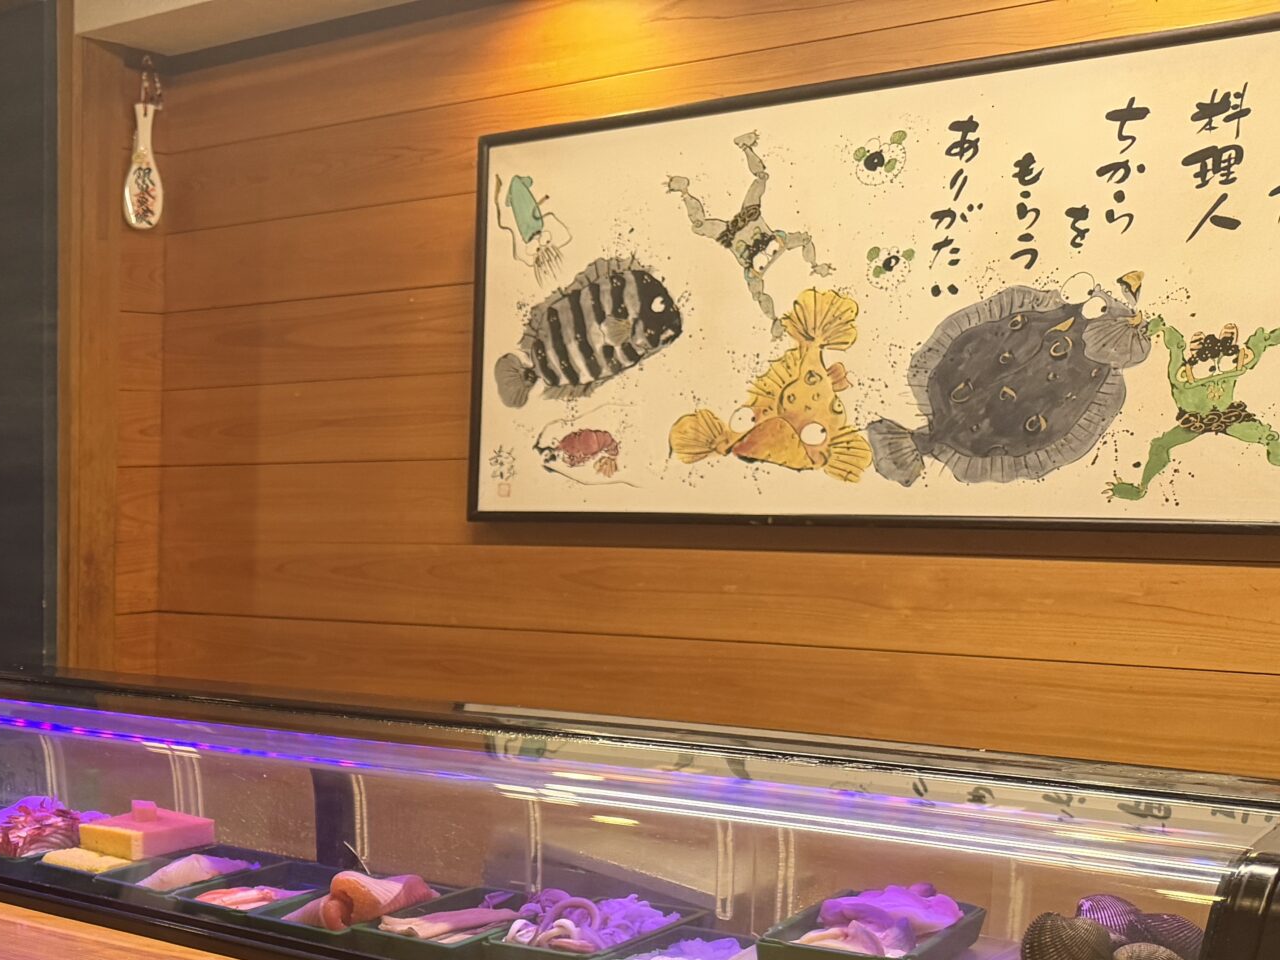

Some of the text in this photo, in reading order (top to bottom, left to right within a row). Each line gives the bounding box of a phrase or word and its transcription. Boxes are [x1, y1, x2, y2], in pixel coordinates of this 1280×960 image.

[929, 115, 984, 297] ありがたい
[1009, 152, 1045, 270] もらう
[1181, 81, 1252, 243] 料理人
